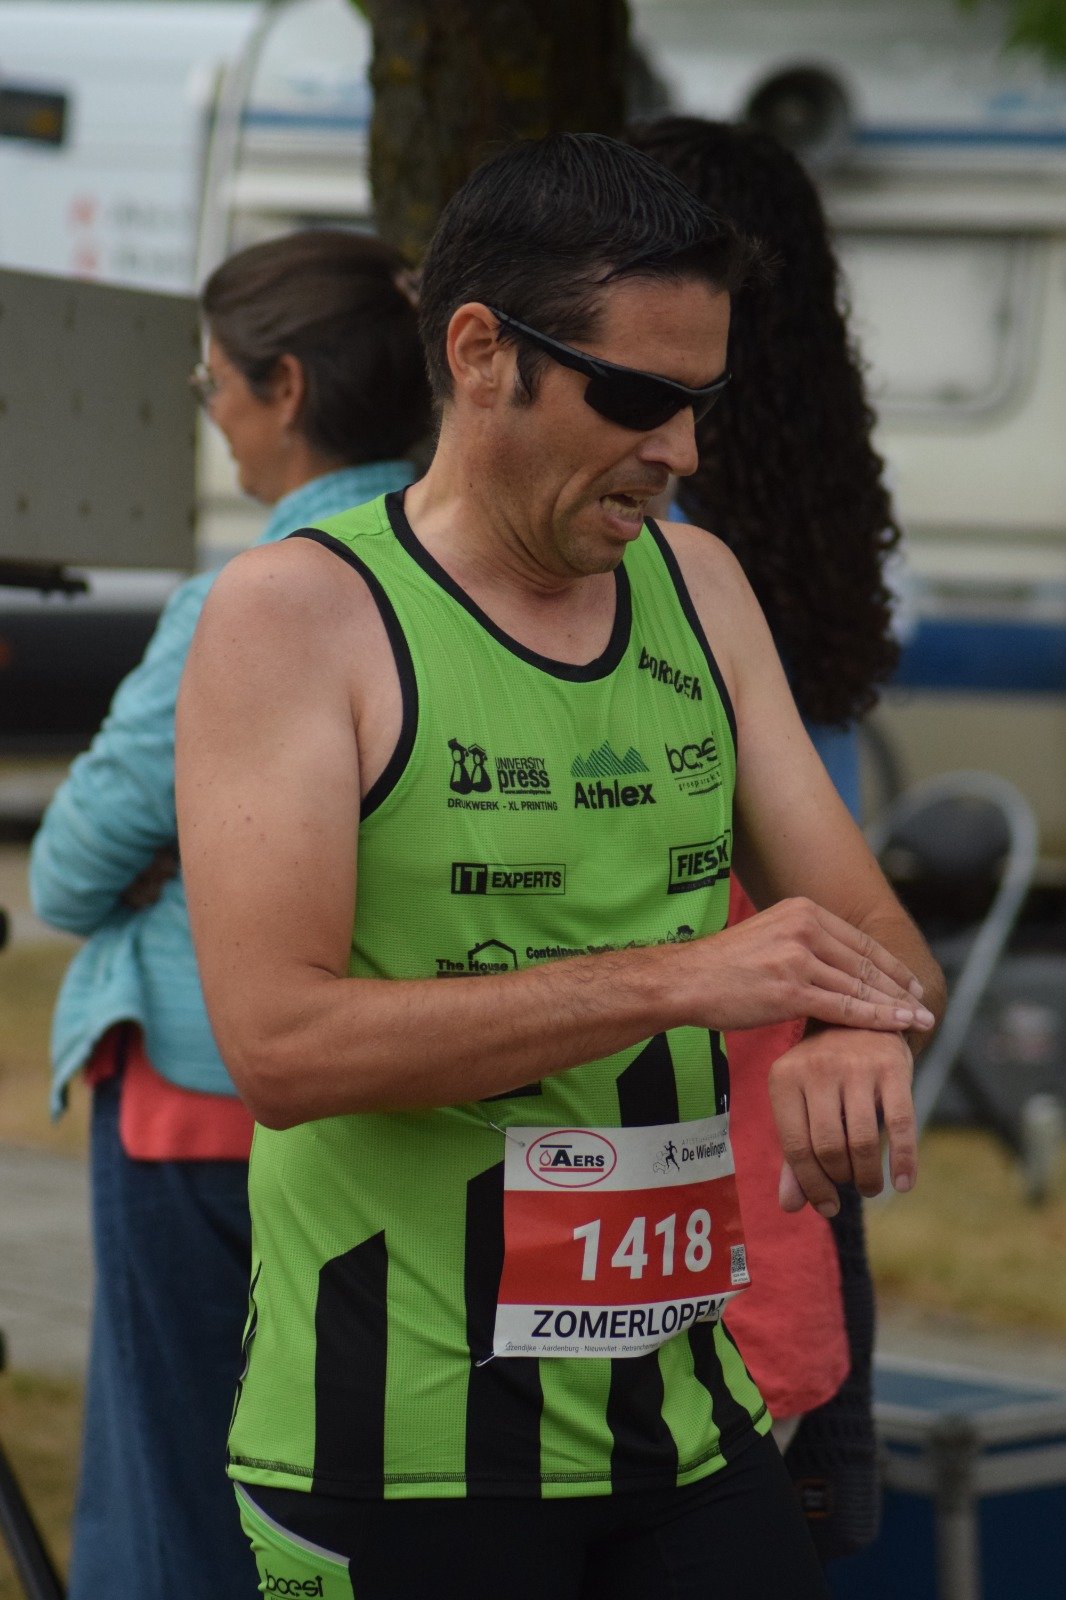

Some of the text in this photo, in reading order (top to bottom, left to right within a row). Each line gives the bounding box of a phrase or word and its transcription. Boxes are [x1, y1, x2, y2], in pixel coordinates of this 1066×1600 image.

[495, 757, 545, 770] UNIVERSITY
[497, 769, 550, 793] press
[574, 779, 656, 809] Athlex
[508, 801, 519, 811] XL
[521, 801, 558, 811] PRINTING
[455, 866, 562, 892] IT EXPERTS
[436, 959, 508, 971] The House
[551, 1149, 605, 1167] AERS
[682, 1142, 727, 1162] De Wielingen
[573, 1208, 712, 1281] 1418
[542, 1344, 579, 1353] Aardenburg
[584, 1344, 617, 1352] Nieuwvliet
